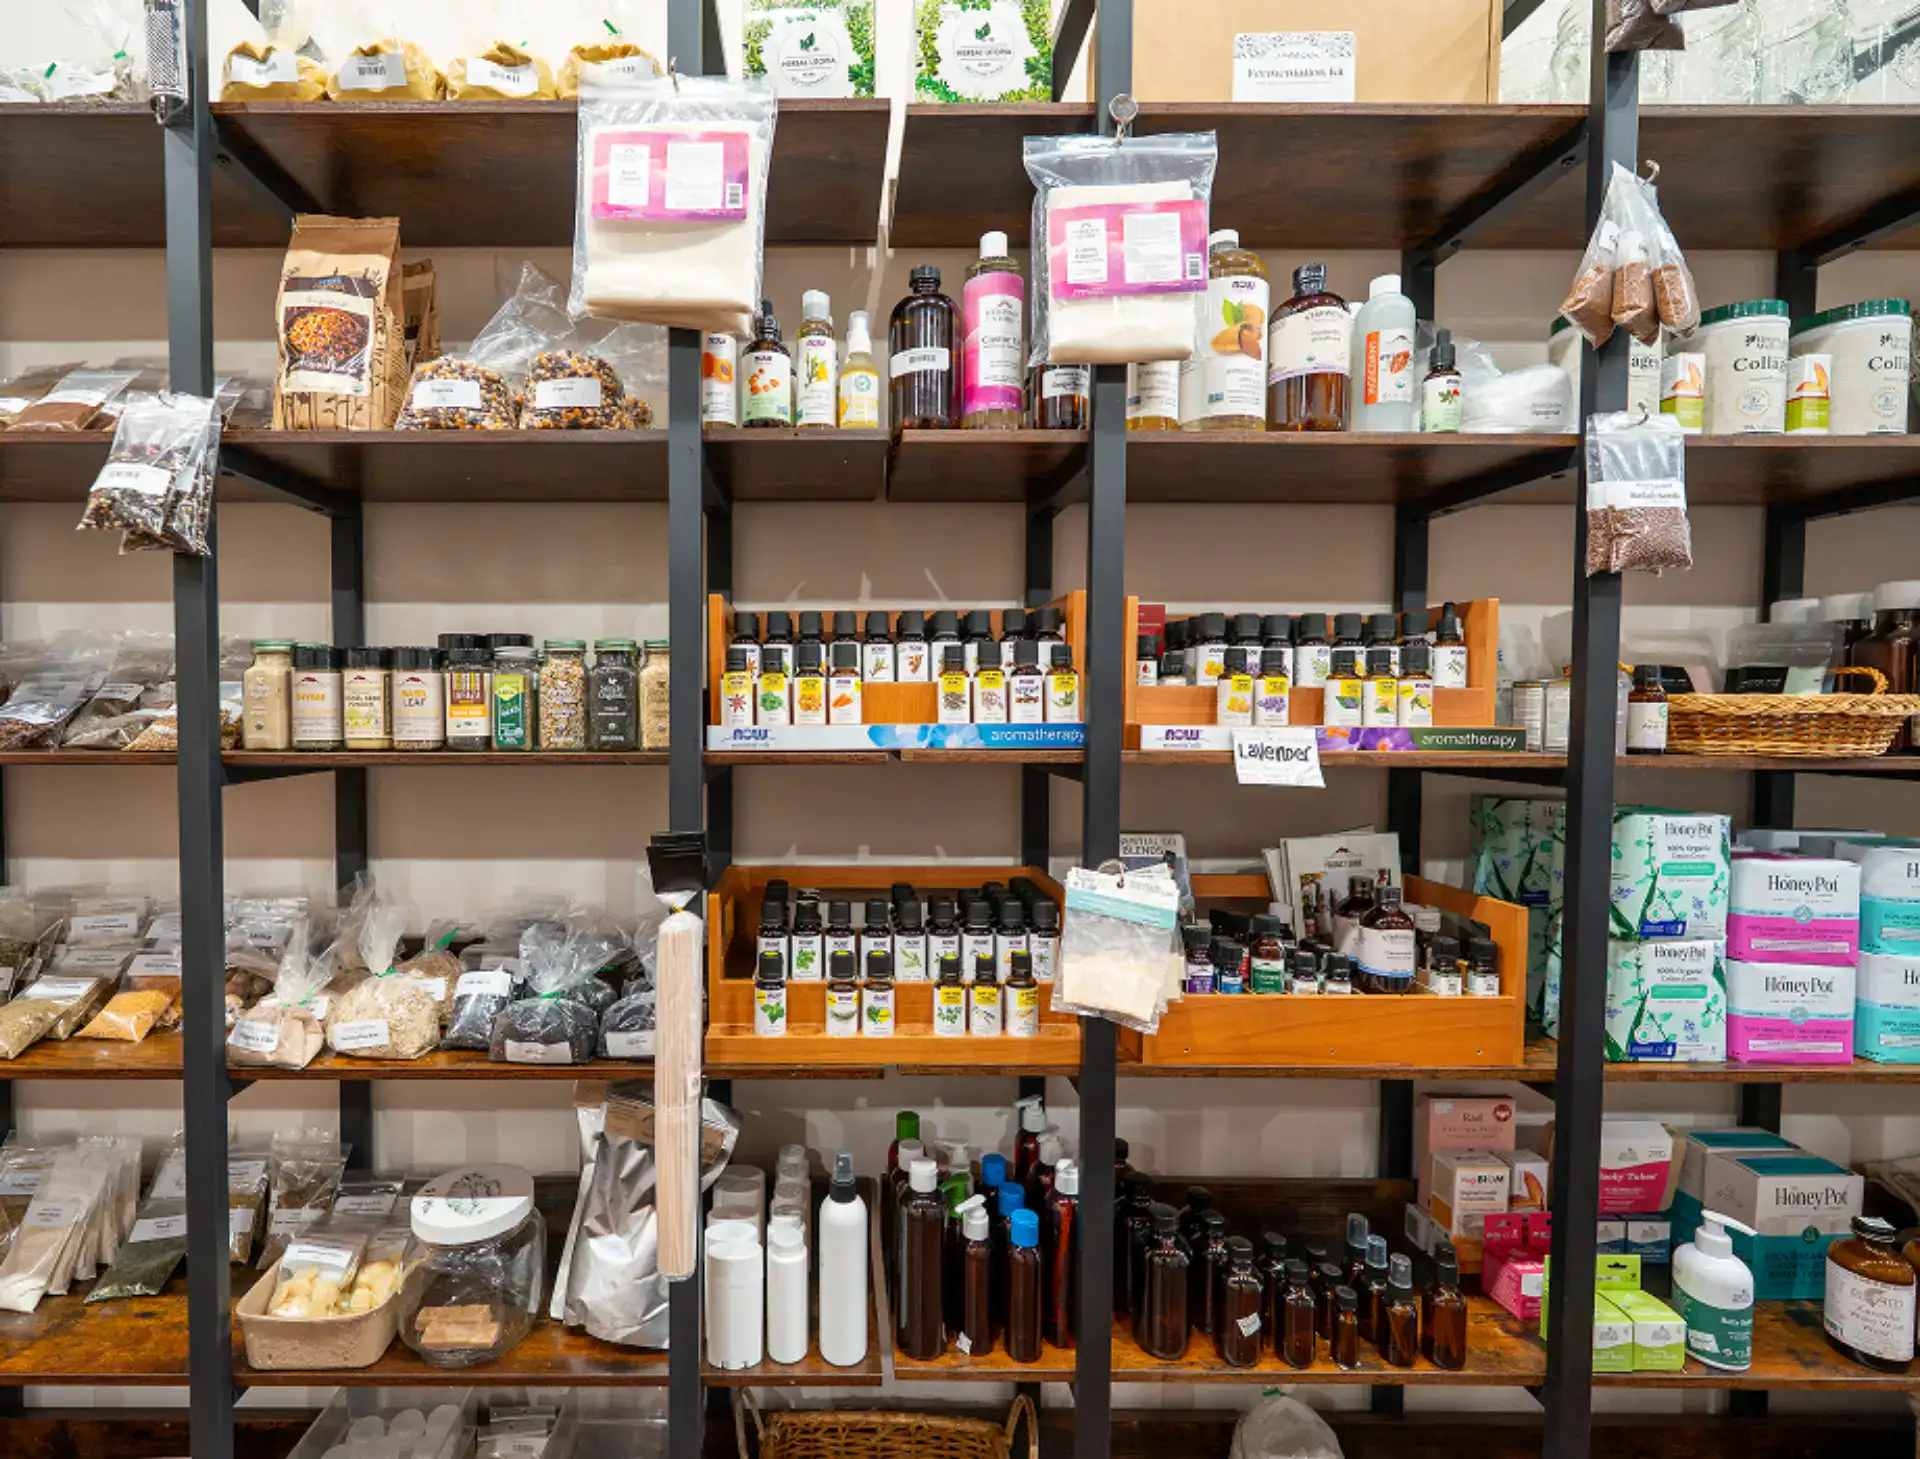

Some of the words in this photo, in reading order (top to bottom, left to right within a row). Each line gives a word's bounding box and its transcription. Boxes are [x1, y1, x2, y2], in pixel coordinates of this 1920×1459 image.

[1247, 68, 1327, 78] Fermentation
[991, 729, 1085, 743] aromatherapy
[1165, 729, 1201, 741] now
[1421, 733, 1517, 749] aromatherapy
[1665, 822, 1697, 838] Honey
[1767, 875, 1815, 895] Honey
[1815, 876, 1839, 893] Pot
[1654, 945, 1688, 962] Honey
[1765, 976, 1810, 997] Honey
[1811, 977, 1834, 993] Pot
[1775, 1187, 1825, 1211] Honey
[1825, 1186, 1848, 1206] Pot
